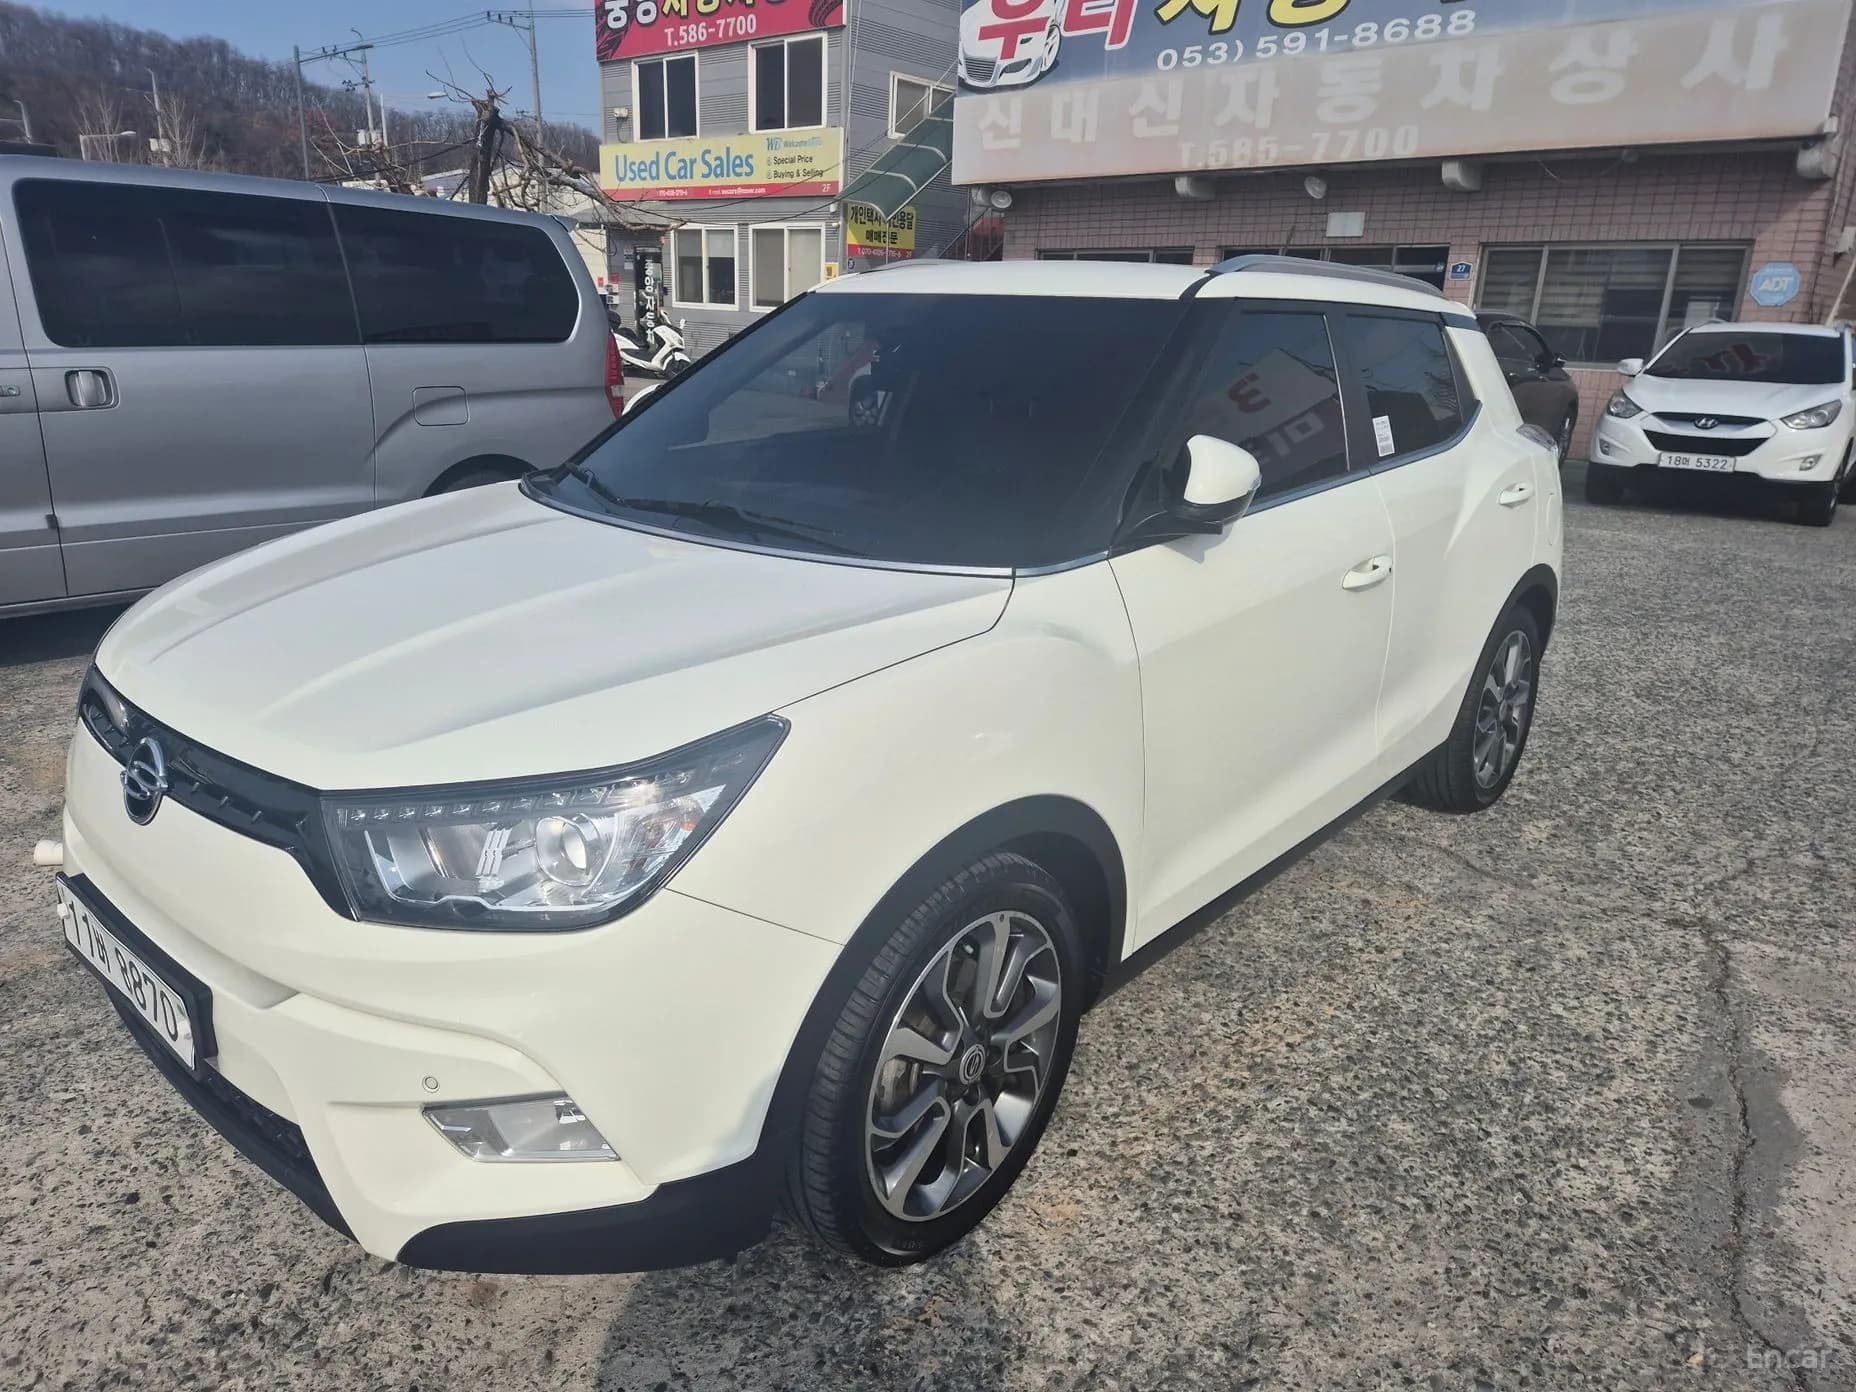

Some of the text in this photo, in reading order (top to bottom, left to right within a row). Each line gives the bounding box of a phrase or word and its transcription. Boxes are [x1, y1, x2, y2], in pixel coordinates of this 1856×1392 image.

[664, 14, 757, 47] T.586-7700
[615, 146, 754, 183] Used Car Sales
[773, 155, 813, 165] Special Price
[773, 168, 824, 179] Buying & Selling
[822, 184, 831, 193] 2F
[1457, 265, 1466, 273] 27
[1759, 276, 1793, 293] ADT
[1695, 457, 1728, 470] 5322
[115, 947, 178, 1041] 8870
